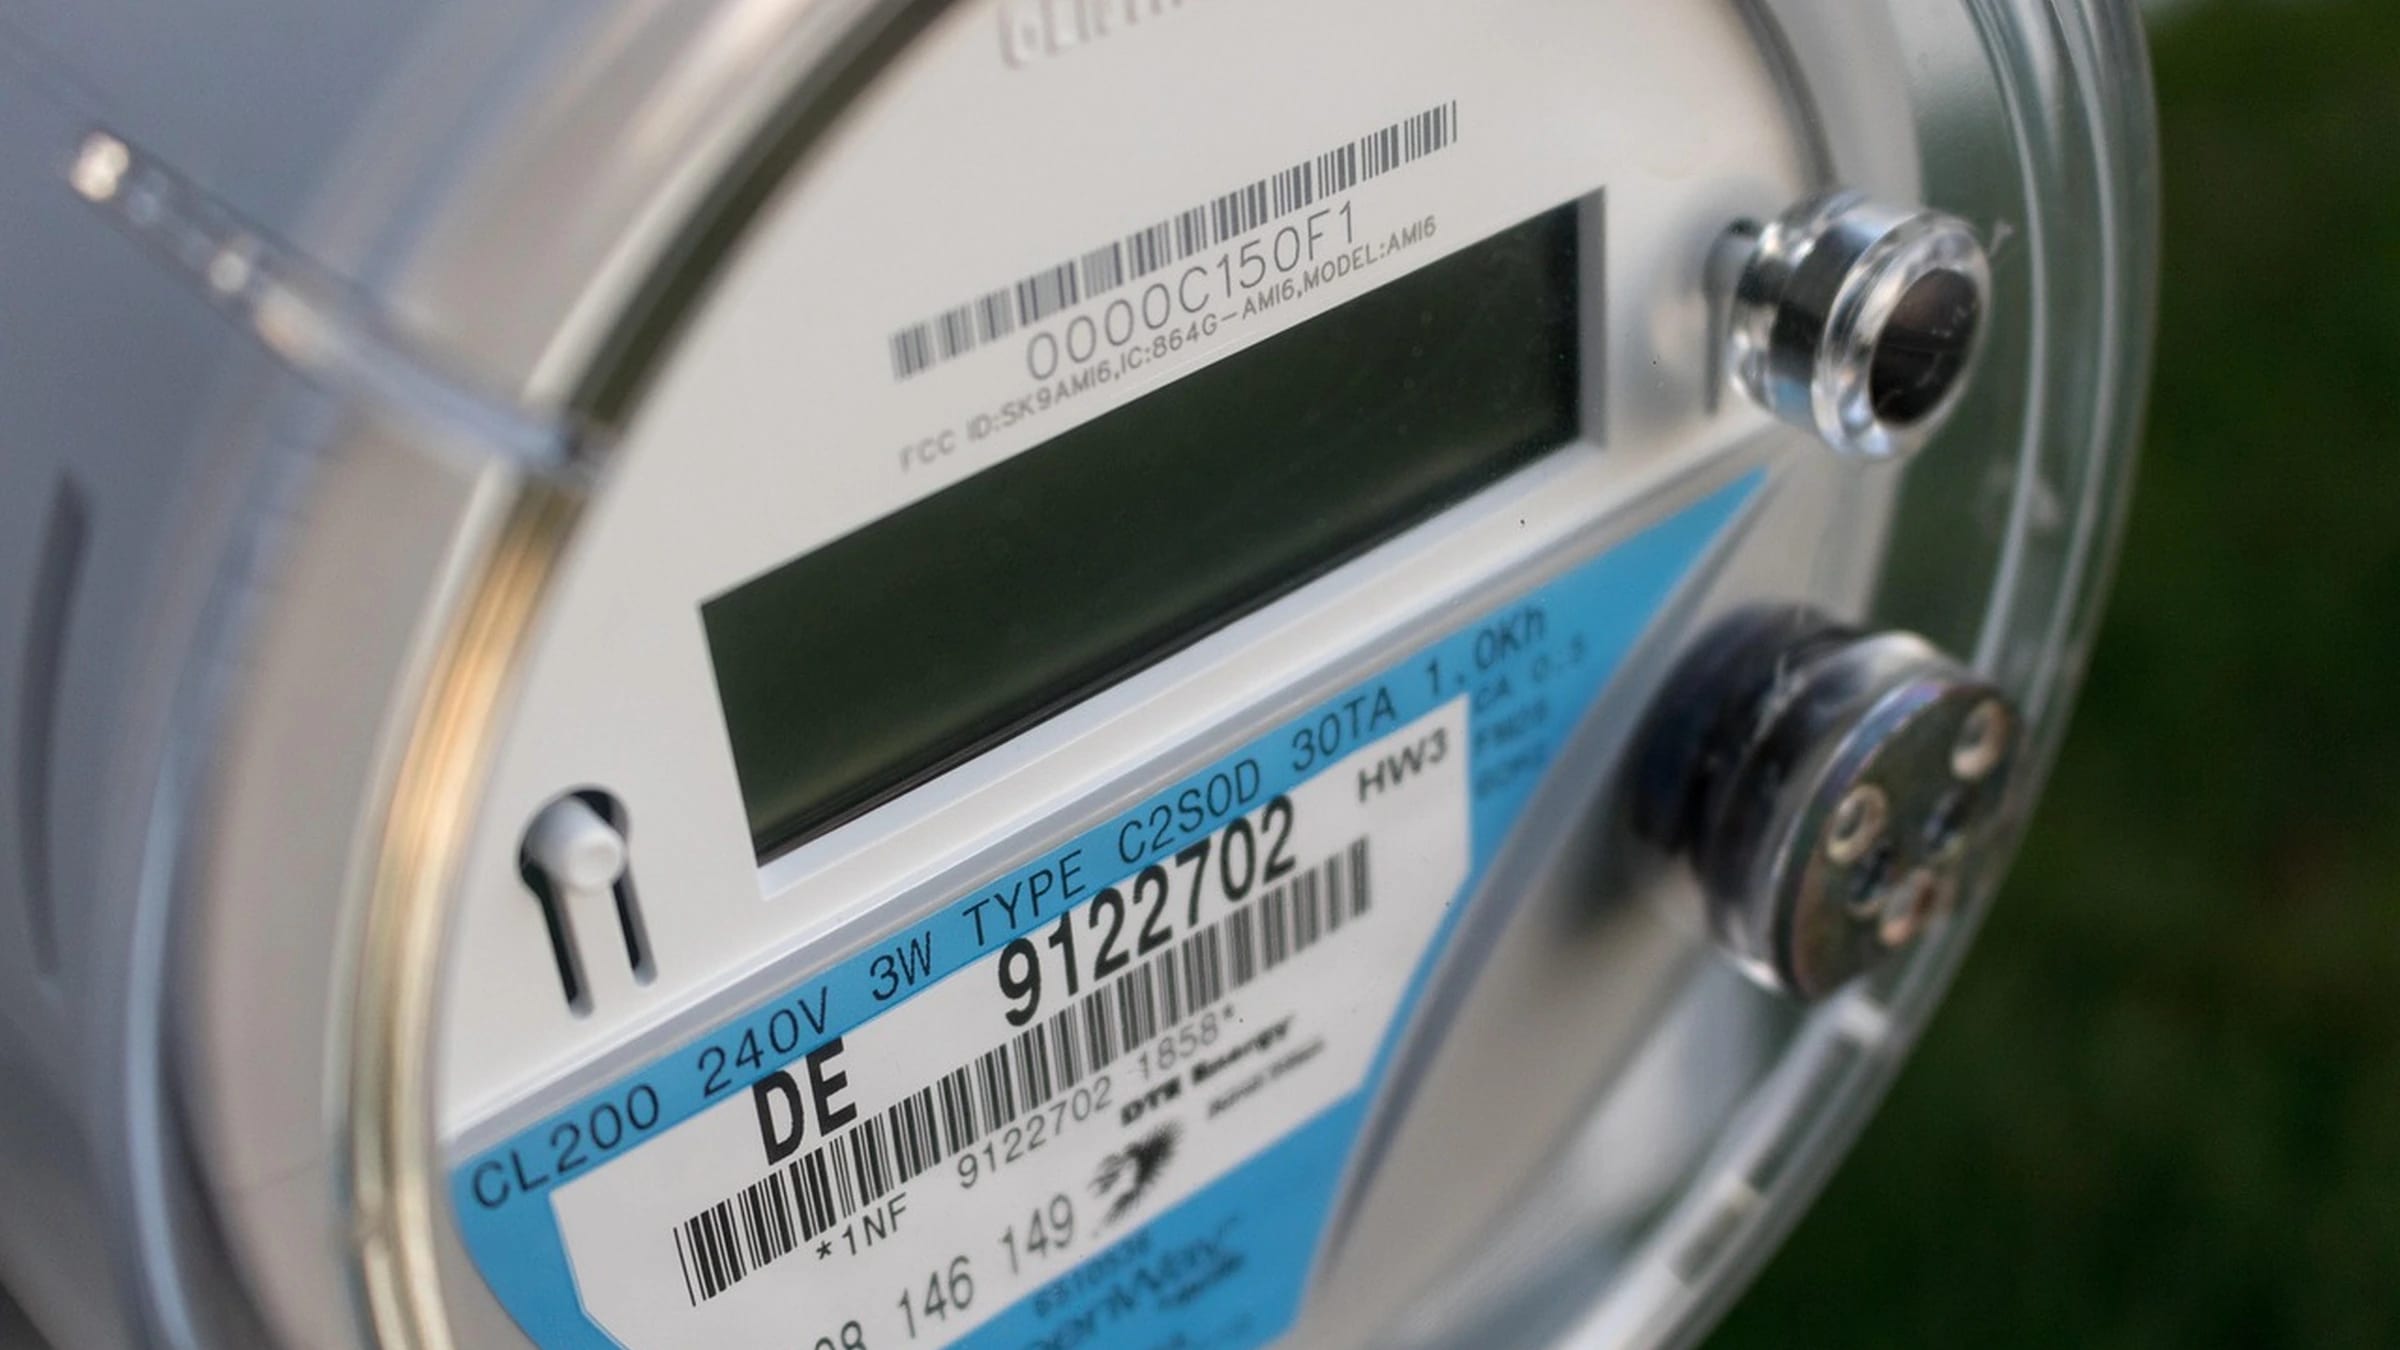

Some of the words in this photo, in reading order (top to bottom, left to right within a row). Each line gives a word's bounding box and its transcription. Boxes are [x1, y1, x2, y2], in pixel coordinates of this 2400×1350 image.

[1026, 202, 1354, 380] 0000C150F1
[900, 430, 955, 473] FCC
[1357, 726, 1450, 803] HW3
[472, 1083, 660, 1211] CL200
[697, 987, 829, 1097] 240V
[869, 931, 932, 1001] 3W
[963, 849, 1087, 947] TYPE
[1291, 686, 1397, 772] 30TA
[998, 795, 1296, 1028] 9122702
[752, 1035, 858, 1167] DE
[957, 1076, 1112, 1189] 9122702
[898, 1255, 974, 1340] 146
[1001, 1194, 1075, 1276] 149
